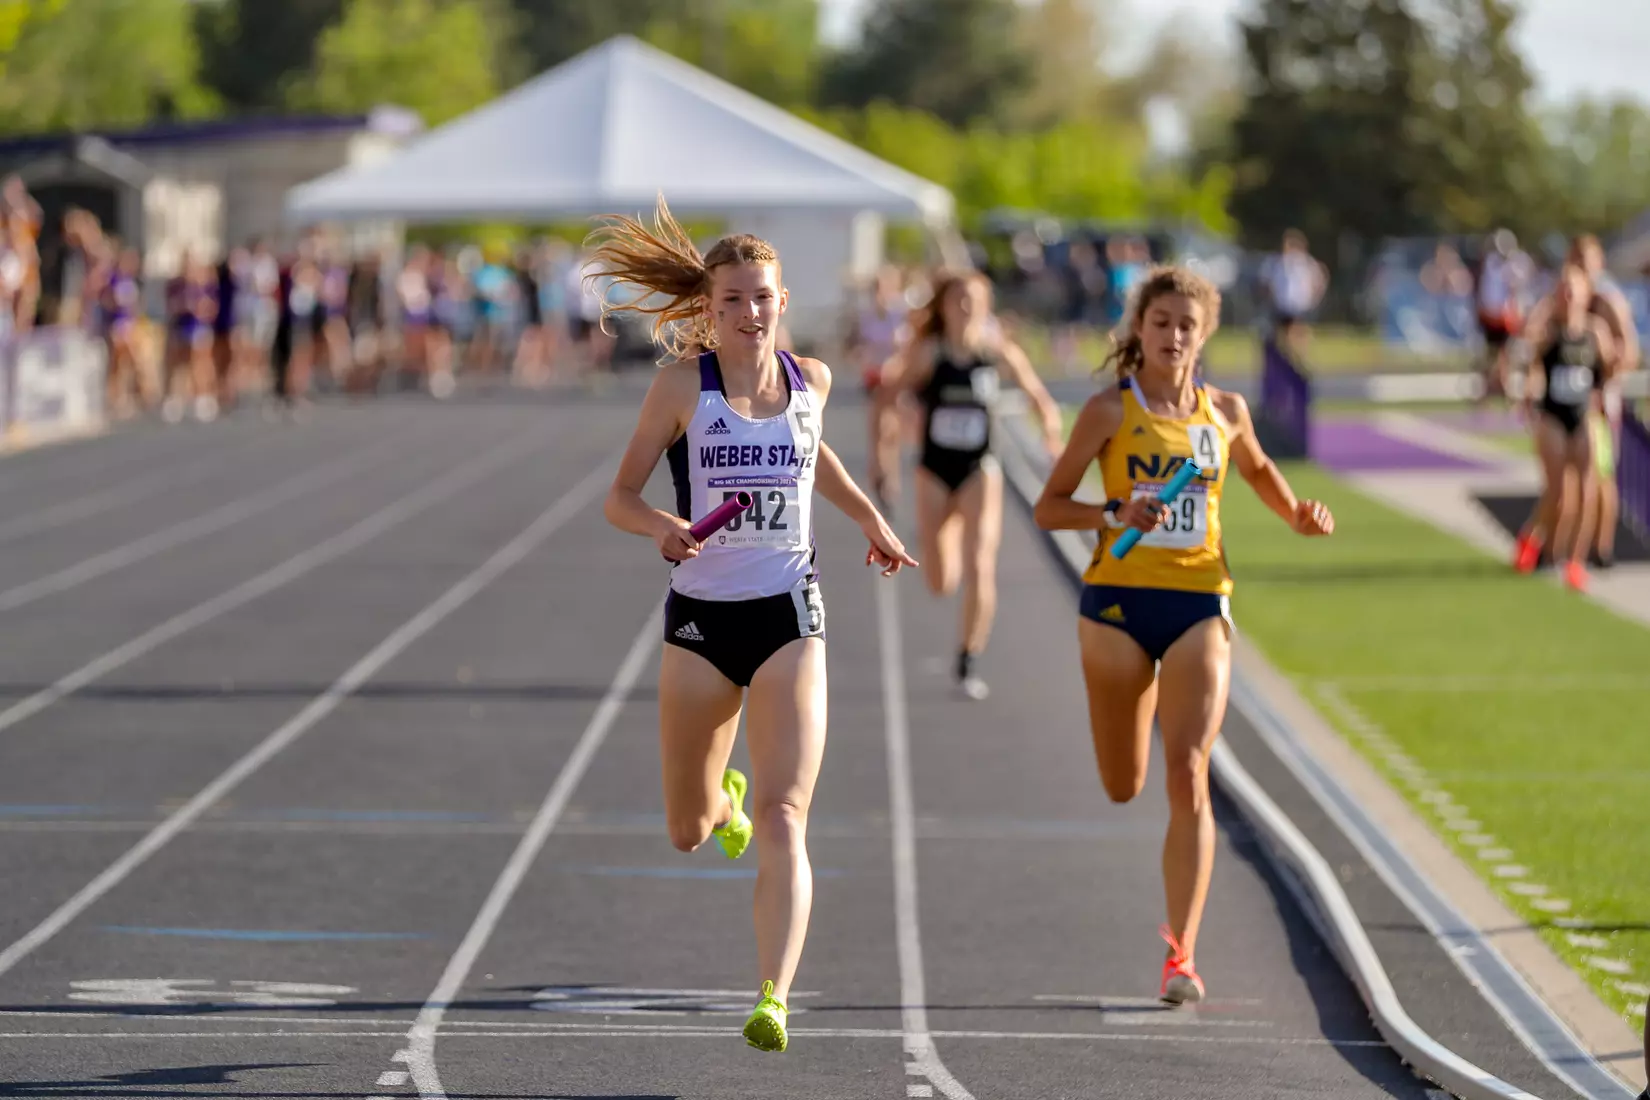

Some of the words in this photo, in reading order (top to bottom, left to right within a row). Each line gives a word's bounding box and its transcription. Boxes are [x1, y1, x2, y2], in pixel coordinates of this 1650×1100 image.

[704, 427, 731, 436] adidas
[795, 411, 815, 454] 5
[1200, 428, 1216, 465] 4
[700, 444, 763, 469] WEBER
[736, 477, 779, 485] CHAMPIONSHIPS
[674, 630, 705, 642] adidas
